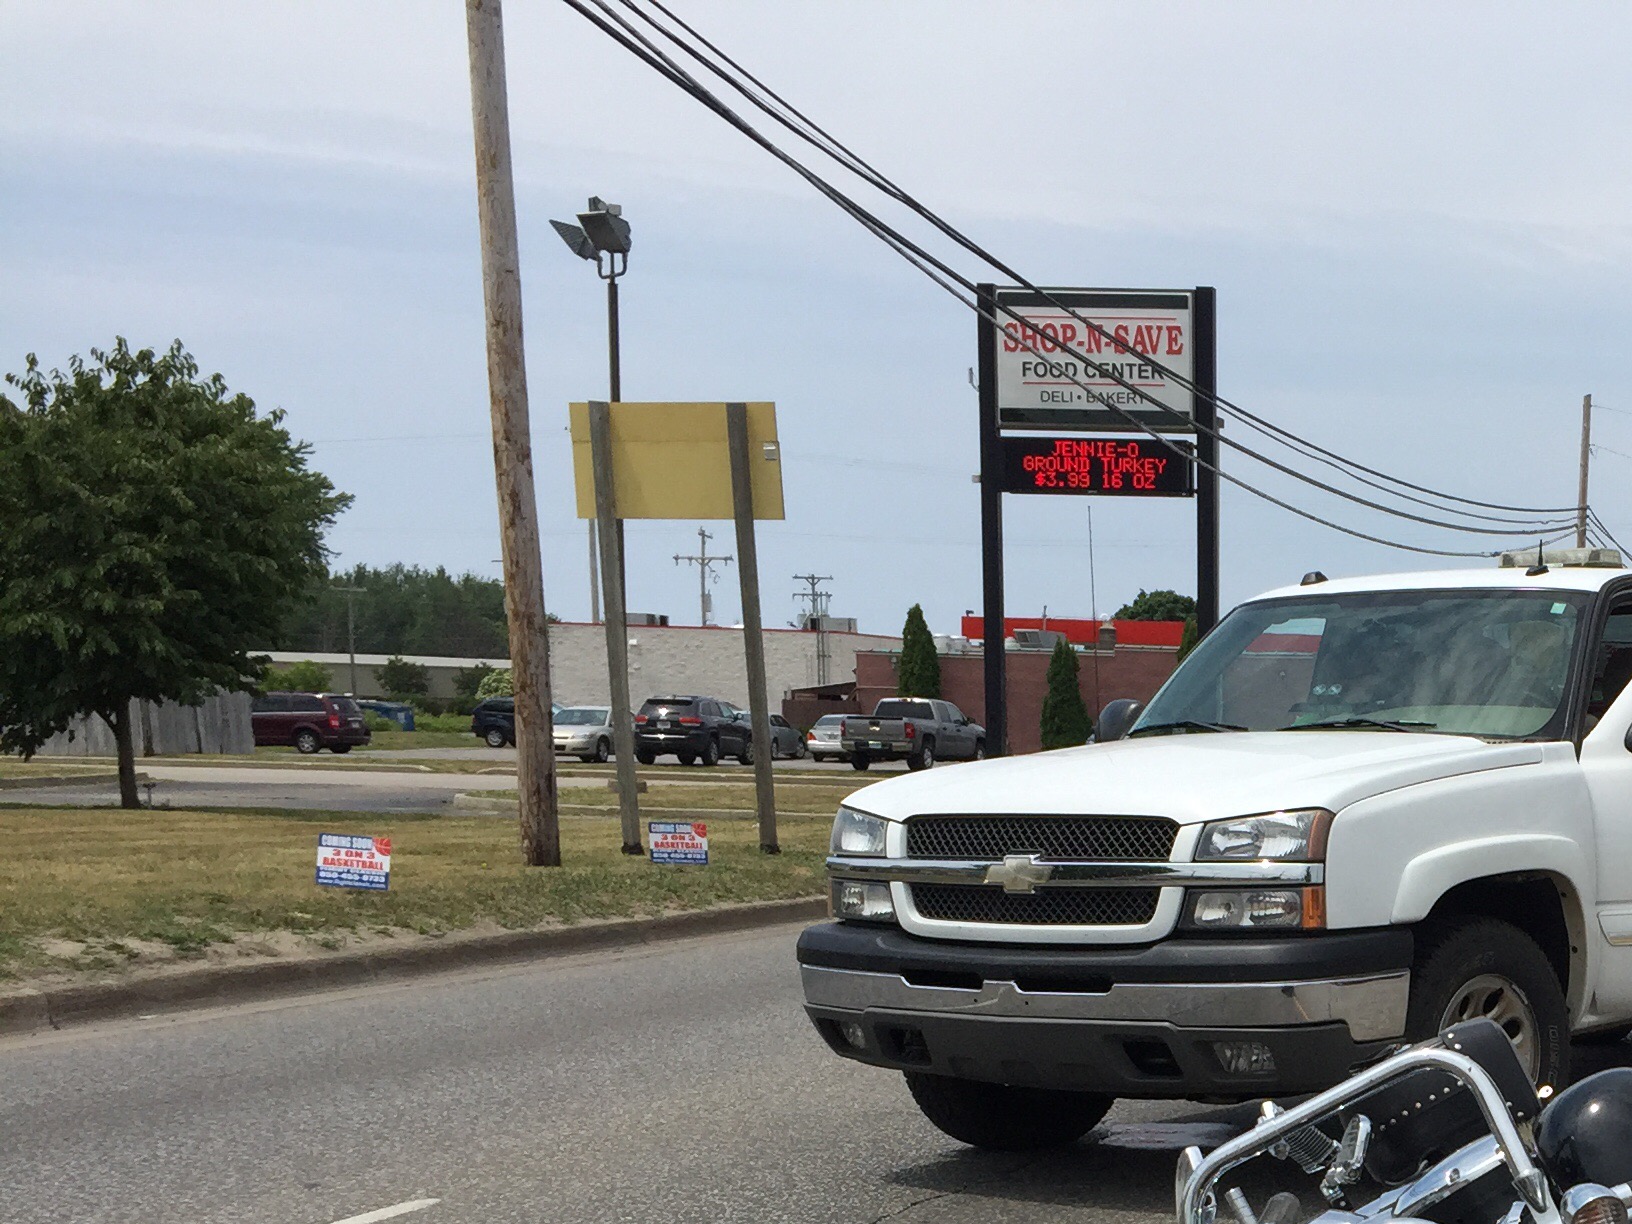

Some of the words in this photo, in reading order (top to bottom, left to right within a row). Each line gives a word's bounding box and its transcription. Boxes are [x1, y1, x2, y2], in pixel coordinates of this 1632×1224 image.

[1003, 322, 1184, 356] SHOP-N-SAVE
[1022, 361, 1077, 378] FOOD
[1084, 362, 1165, 380] CENTER
[1040, 390, 1073, 403] DELI
[1087, 391, 1147, 404] BAKERY
[1051, 440, 1139, 457] JENNIE-O
[1022, 456, 1090, 472] GROUND
[1101, 458, 1167, 474] TURKEY
[1034, 472, 1091, 488] $3.99
[1102, 473, 1123, 488] 16
[1133, 474, 1156, 489] OZ
[345, 850, 363, 858] ON
[322, 857, 384, 870] BASKETBALL
